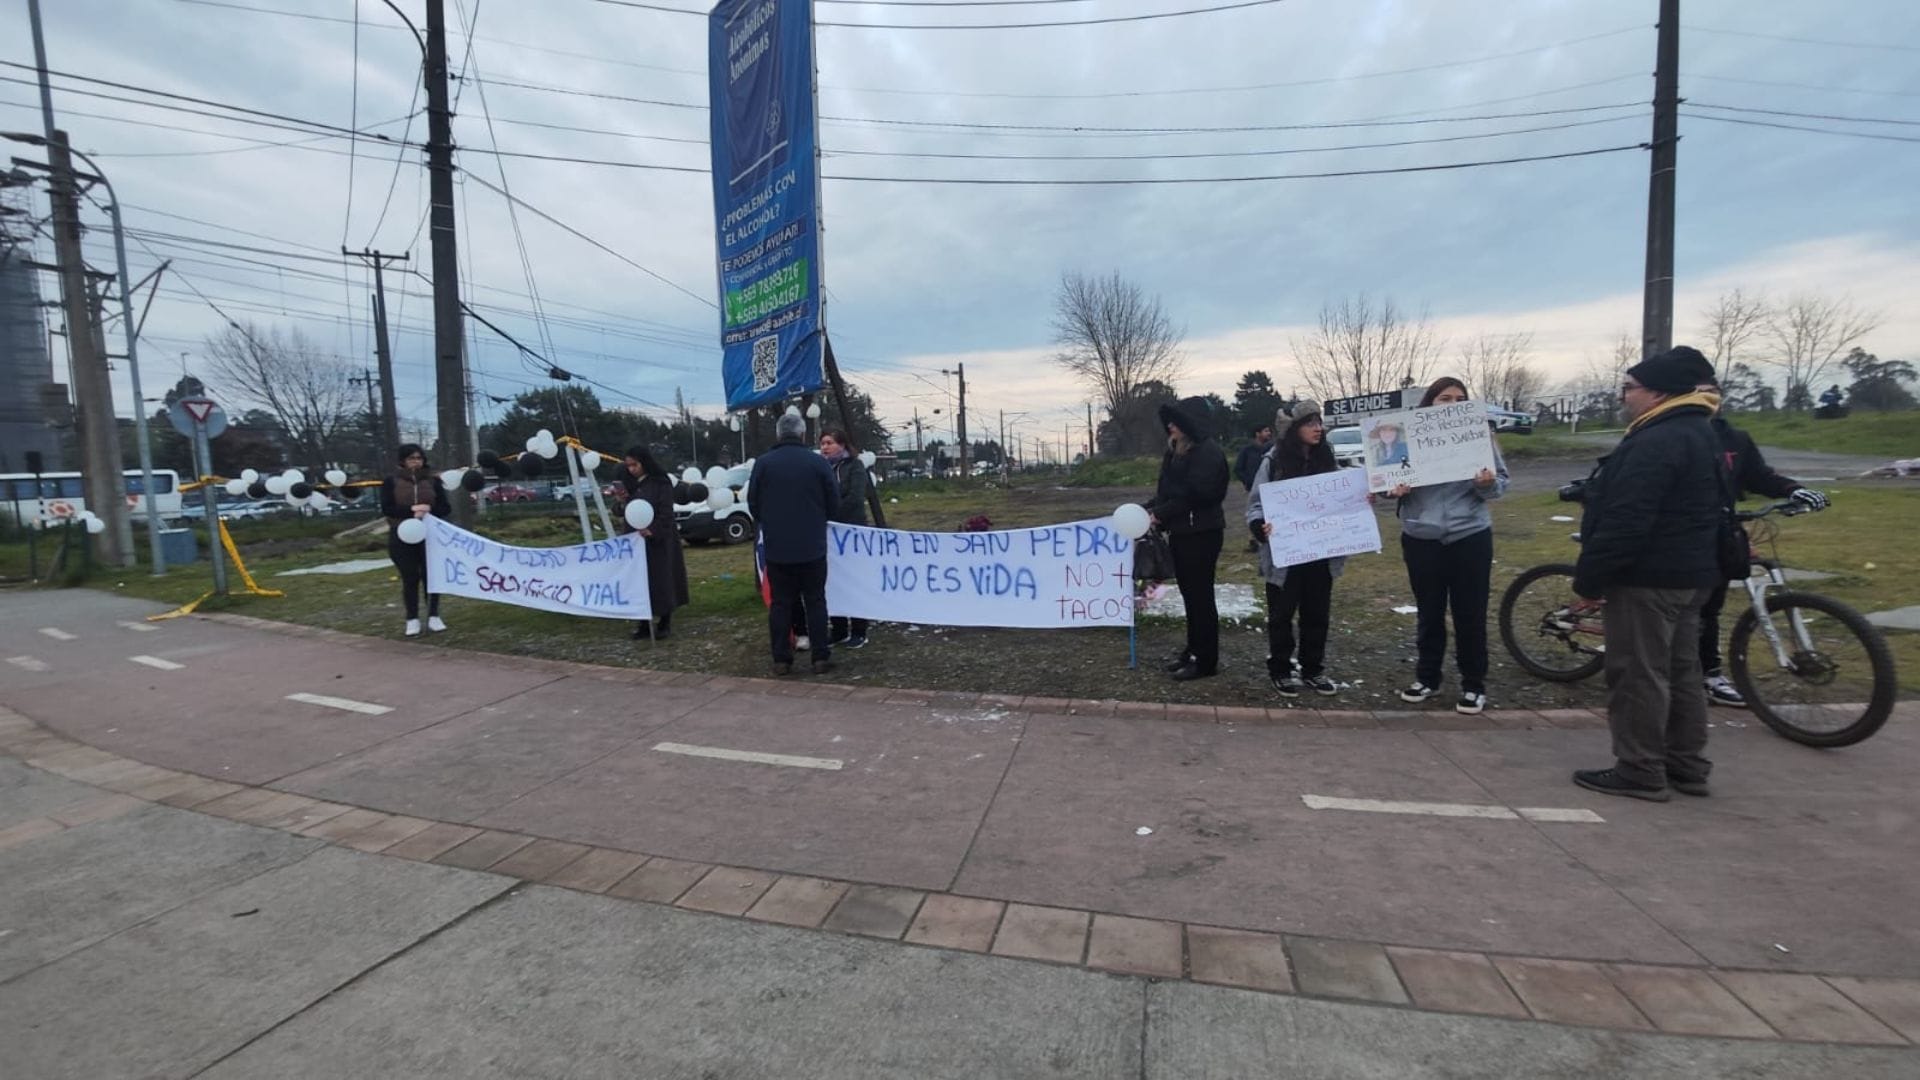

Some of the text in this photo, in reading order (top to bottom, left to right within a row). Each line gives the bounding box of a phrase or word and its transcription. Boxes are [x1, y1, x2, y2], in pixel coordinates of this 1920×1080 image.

[725, 232, 737, 247] EL
[1332, 394, 1392, 415] SE VENDE
[1272, 476, 1352, 505] JUSTICIA
[436, 521, 634, 569] SAN PEDRO ZONA
[831, 526, 900, 557] VIVIR
[909, 533, 940, 554] EN
[952, 532, 1010, 556] SAN
[444, 557, 469, 585] DE
[581, 581, 630, 606] VIAL
[881, 563, 1037, 600] NO ES VIDA
[1065, 560, 1131, 590] NO +
[1055, 594, 1133, 623] TACOS
